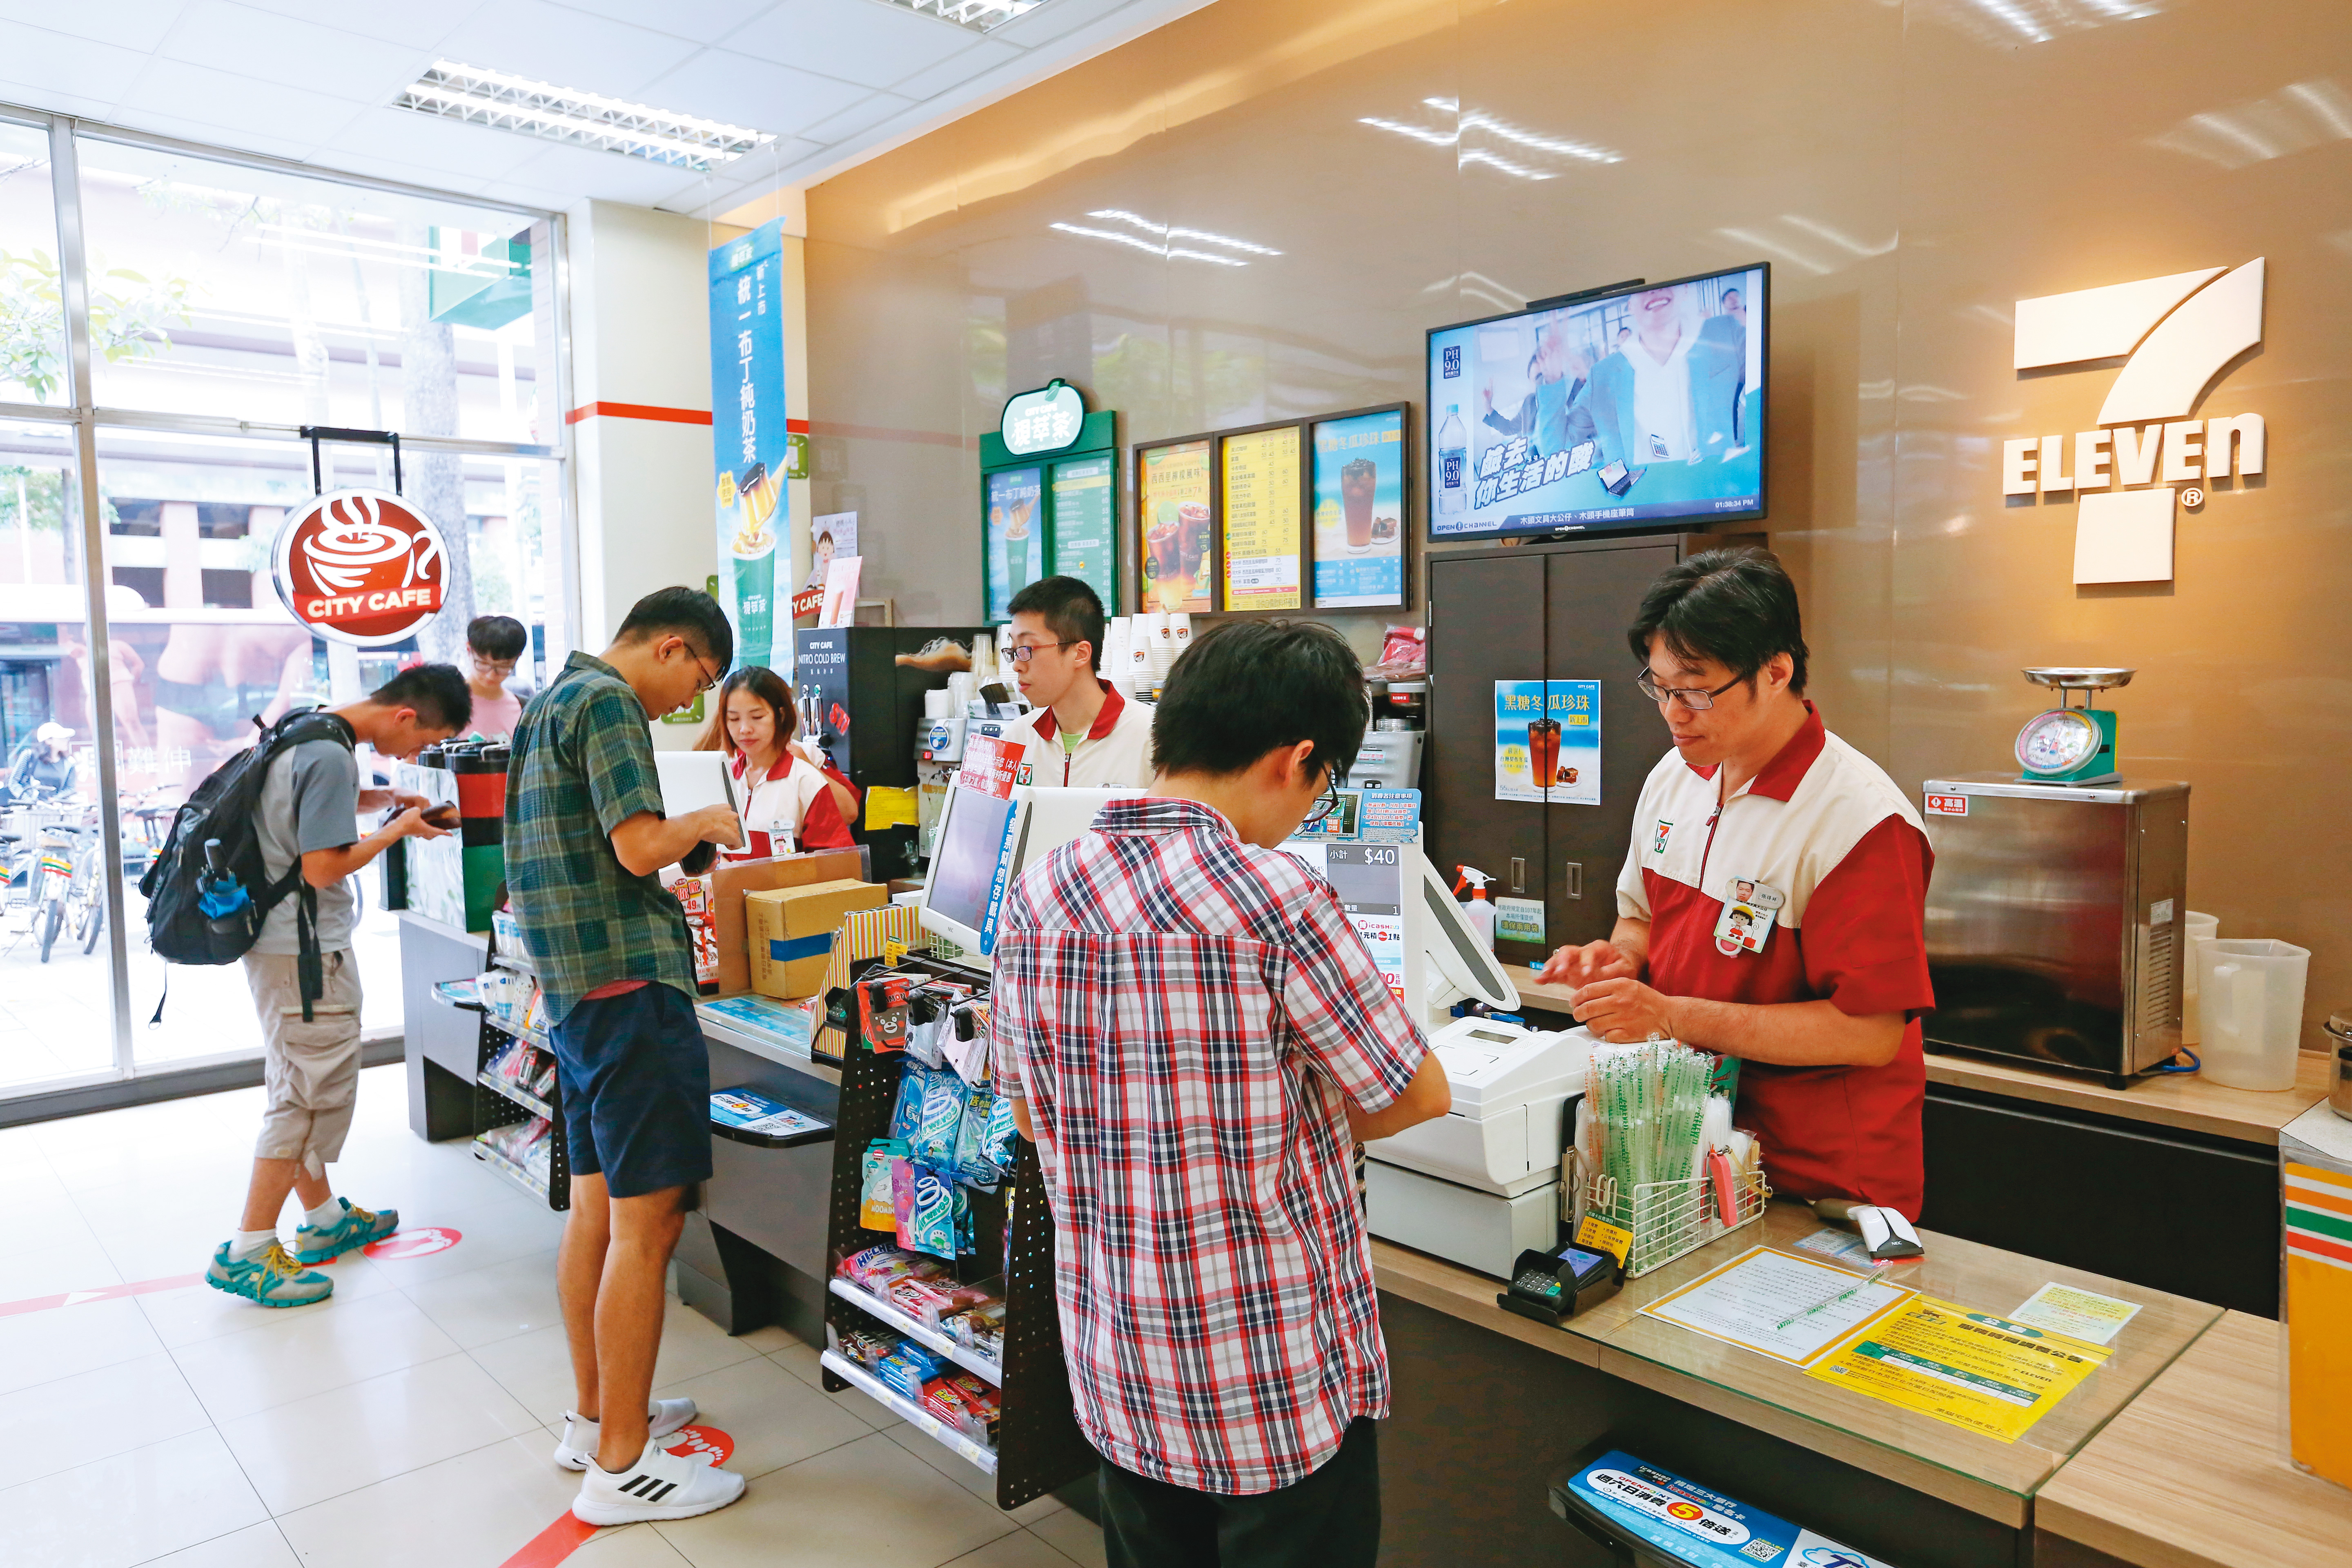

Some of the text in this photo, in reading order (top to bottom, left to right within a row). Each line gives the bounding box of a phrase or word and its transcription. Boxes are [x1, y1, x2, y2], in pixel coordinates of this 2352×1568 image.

[1445, 348, 1459, 361] PH
[737, 275, 756, 463] 統一布丁純奶茶
[1444, 359, 1459, 372] 9.0
[1025, 403, 1057, 416] CITY CAFE
[1011, 411, 1073, 447] 現萃茶
[1318, 432, 1380, 453] 黑糖冬瓜珍珠
[1446, 460, 1459, 471] PH
[1479, 437, 1528, 479] 鹼去
[1446, 470, 1459, 481] 9.0
[1474, 440, 1596, 510] 你生活的酸
[1715, 501, 1742, 509] 01:38:34
[1520, 508, 1635, 526] 木頭文具大公仔、木頭手機座筆筒
[1437, 523, 1455, 532] OPEN
[307, 588, 431, 617] CITY CAFE
[742, 599, 767, 615] 現萃茶
[800, 593, 823, 612] CAFE
[820, 641, 833, 649] CAFE
[798, 653, 846, 664] NITRO COLD BREW
[1505, 694, 1590, 711] 黑糖冬瓜珍珠
[1944, 798, 1963, 808] 高溫
[1330, 847, 1396, 865] 小計 $40
[1393, 906, 1399, 915] 1
[1497, 904, 1542, 915] 依政府規定自107年起
[1501, 920, 1539, 933] 環保兩用袋
[871, 1205, 895, 1214] MOOMIN
[1980, 1316, 2029, 1334] 公告
[1957, 1322, 2085, 1363] 服務時間調整公告
[1934, 1407, 2006, 1433] 黑貓宅急便 敬上
[1674, 1479, 1738, 1508] 指定三大銀行
[1595, 1473, 1732, 1535] 週六日消費 5 倍送
[1712, 1504, 1747, 1520] 聯名卡
